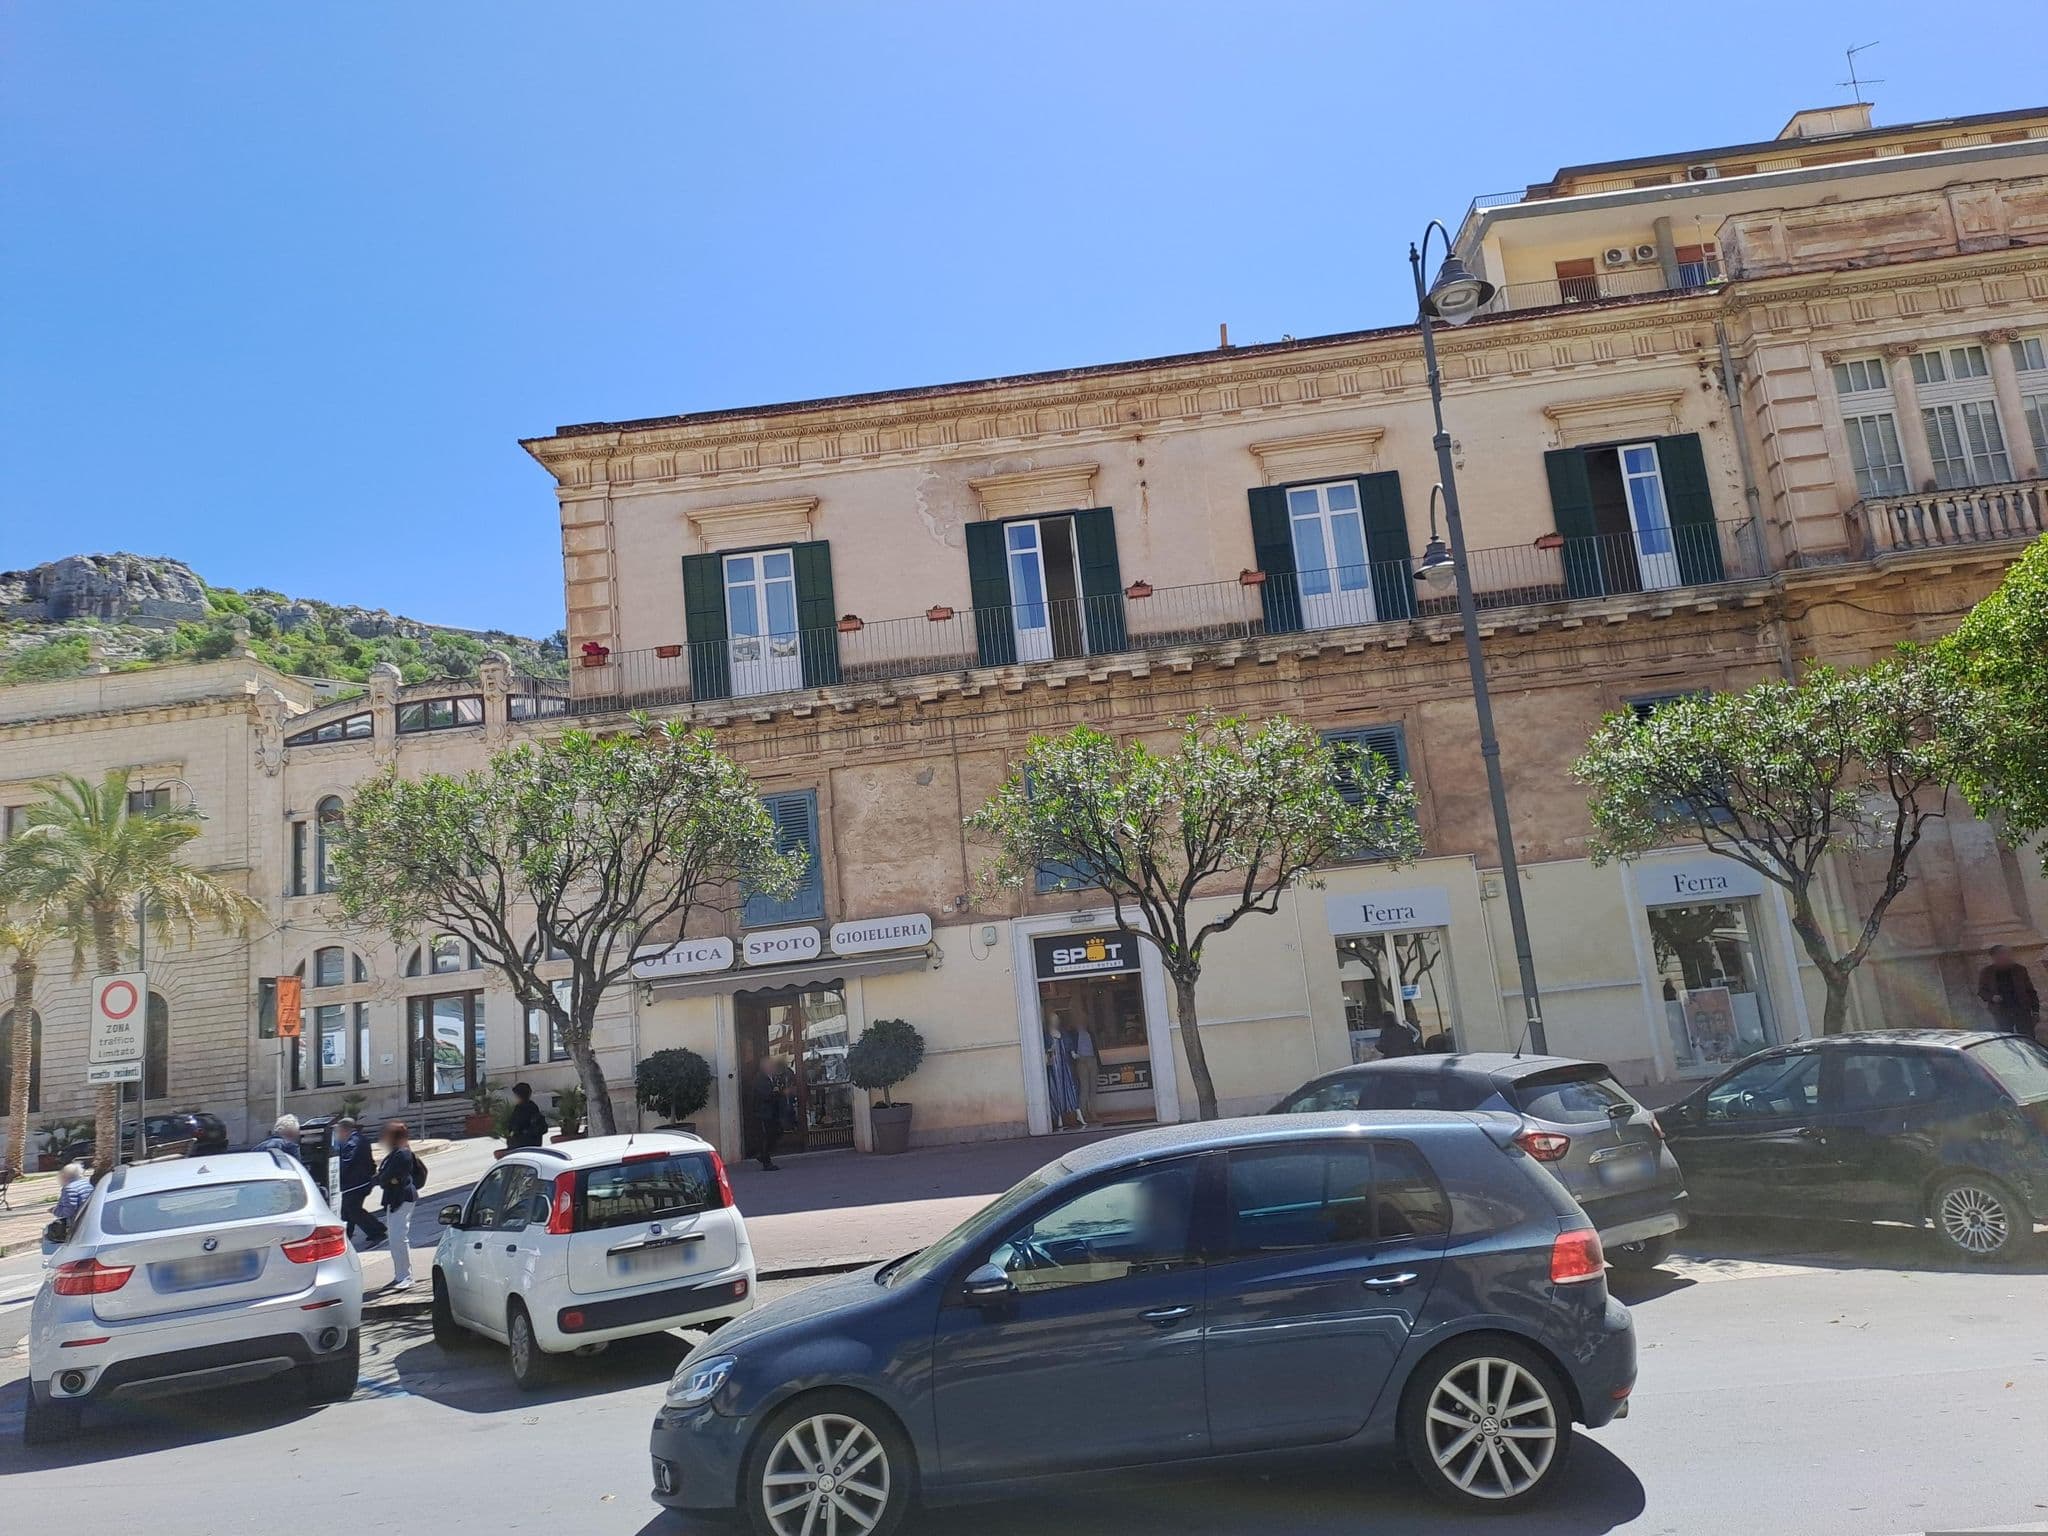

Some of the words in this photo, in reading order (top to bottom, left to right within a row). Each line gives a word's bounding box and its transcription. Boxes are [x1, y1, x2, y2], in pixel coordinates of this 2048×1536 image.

[1673, 874, 1729, 892] Ferra
[1362, 904, 1416, 922] Ferra
[749, 936, 815, 955] SPOTO
[836, 923, 927, 945] GIOIELLERIA
[106, 1023, 130, 1034] ZONA
[99, 1036, 135, 1046] traffico
